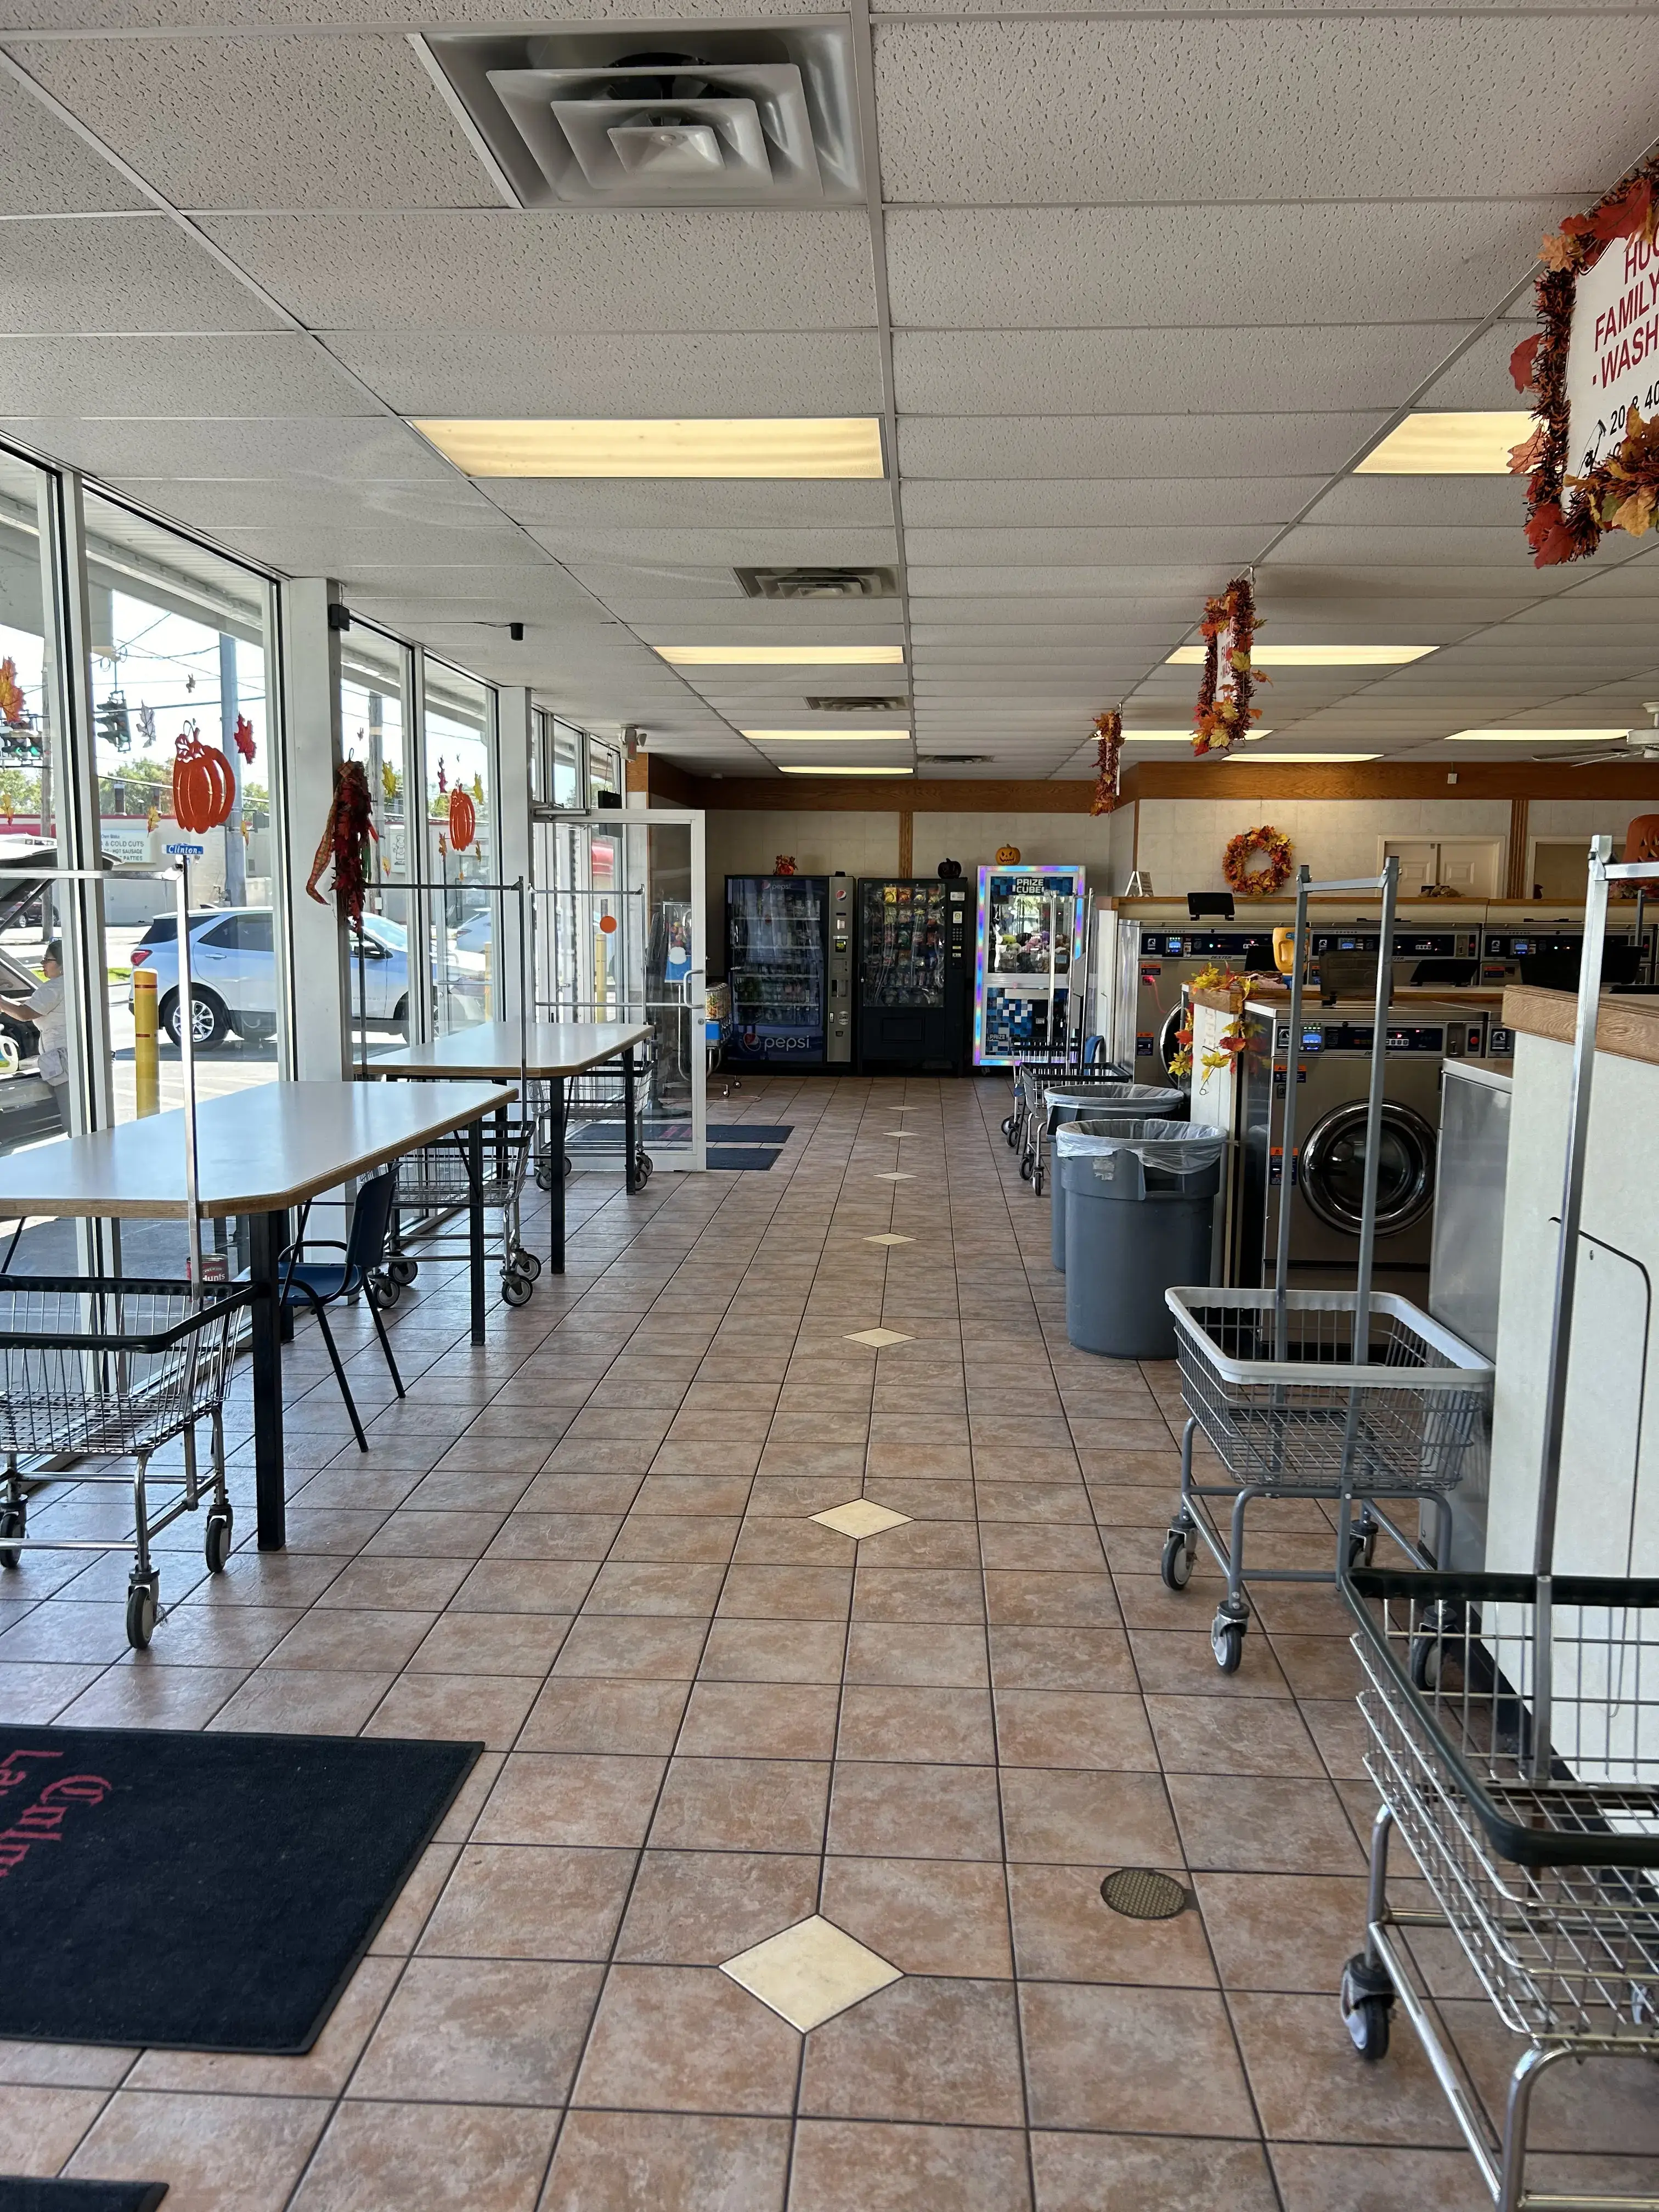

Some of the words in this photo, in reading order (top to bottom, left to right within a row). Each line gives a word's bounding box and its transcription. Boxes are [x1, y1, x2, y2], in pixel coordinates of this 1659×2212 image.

[1594, 268, 1659, 353] FAMILY
[1610, 405, 1626, 436] 20
[168, 845, 198, 854] Clinton
[764, 1035, 810, 1052] pepsi
